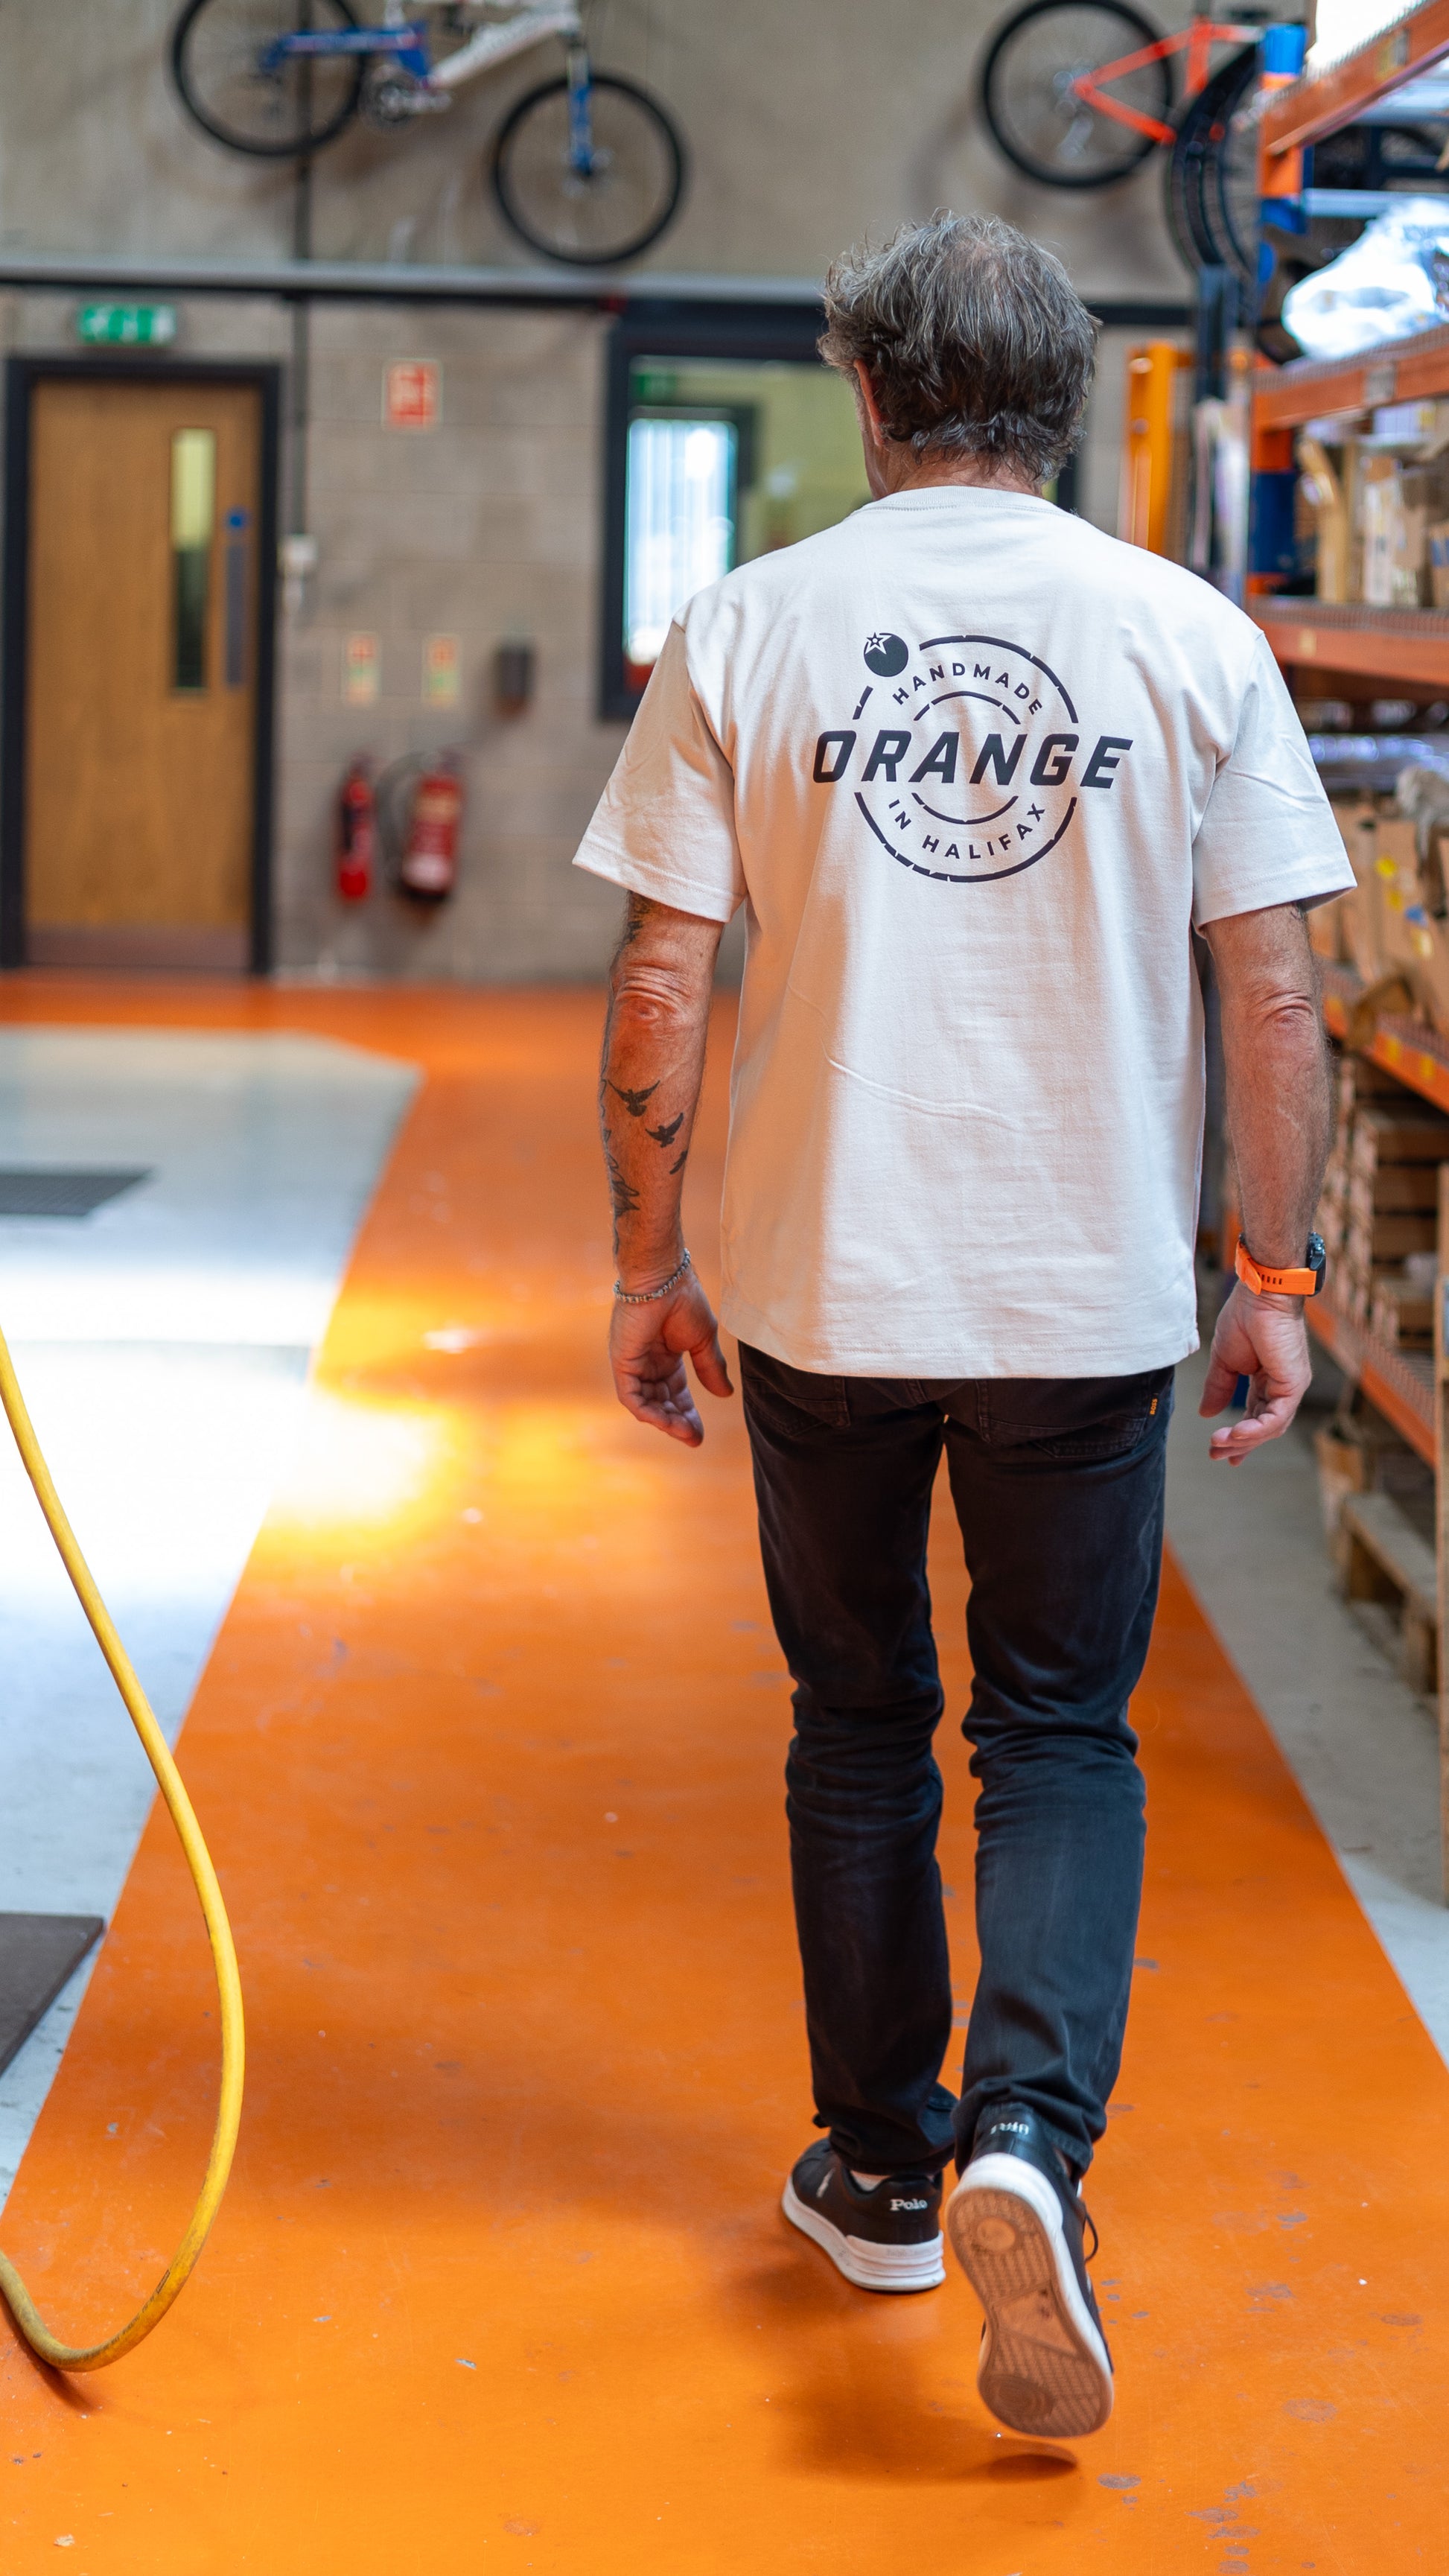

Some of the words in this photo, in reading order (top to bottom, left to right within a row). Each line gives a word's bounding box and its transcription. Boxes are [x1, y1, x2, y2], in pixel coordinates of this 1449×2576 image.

[892, 663, 1043, 716] HANDMADE
[812, 729, 1134, 789] ORANGE
[888, 799, 912, 830] IN
[922, 803, 1046, 859] HALIFAX
[889, 2198, 928, 2212] Polo
